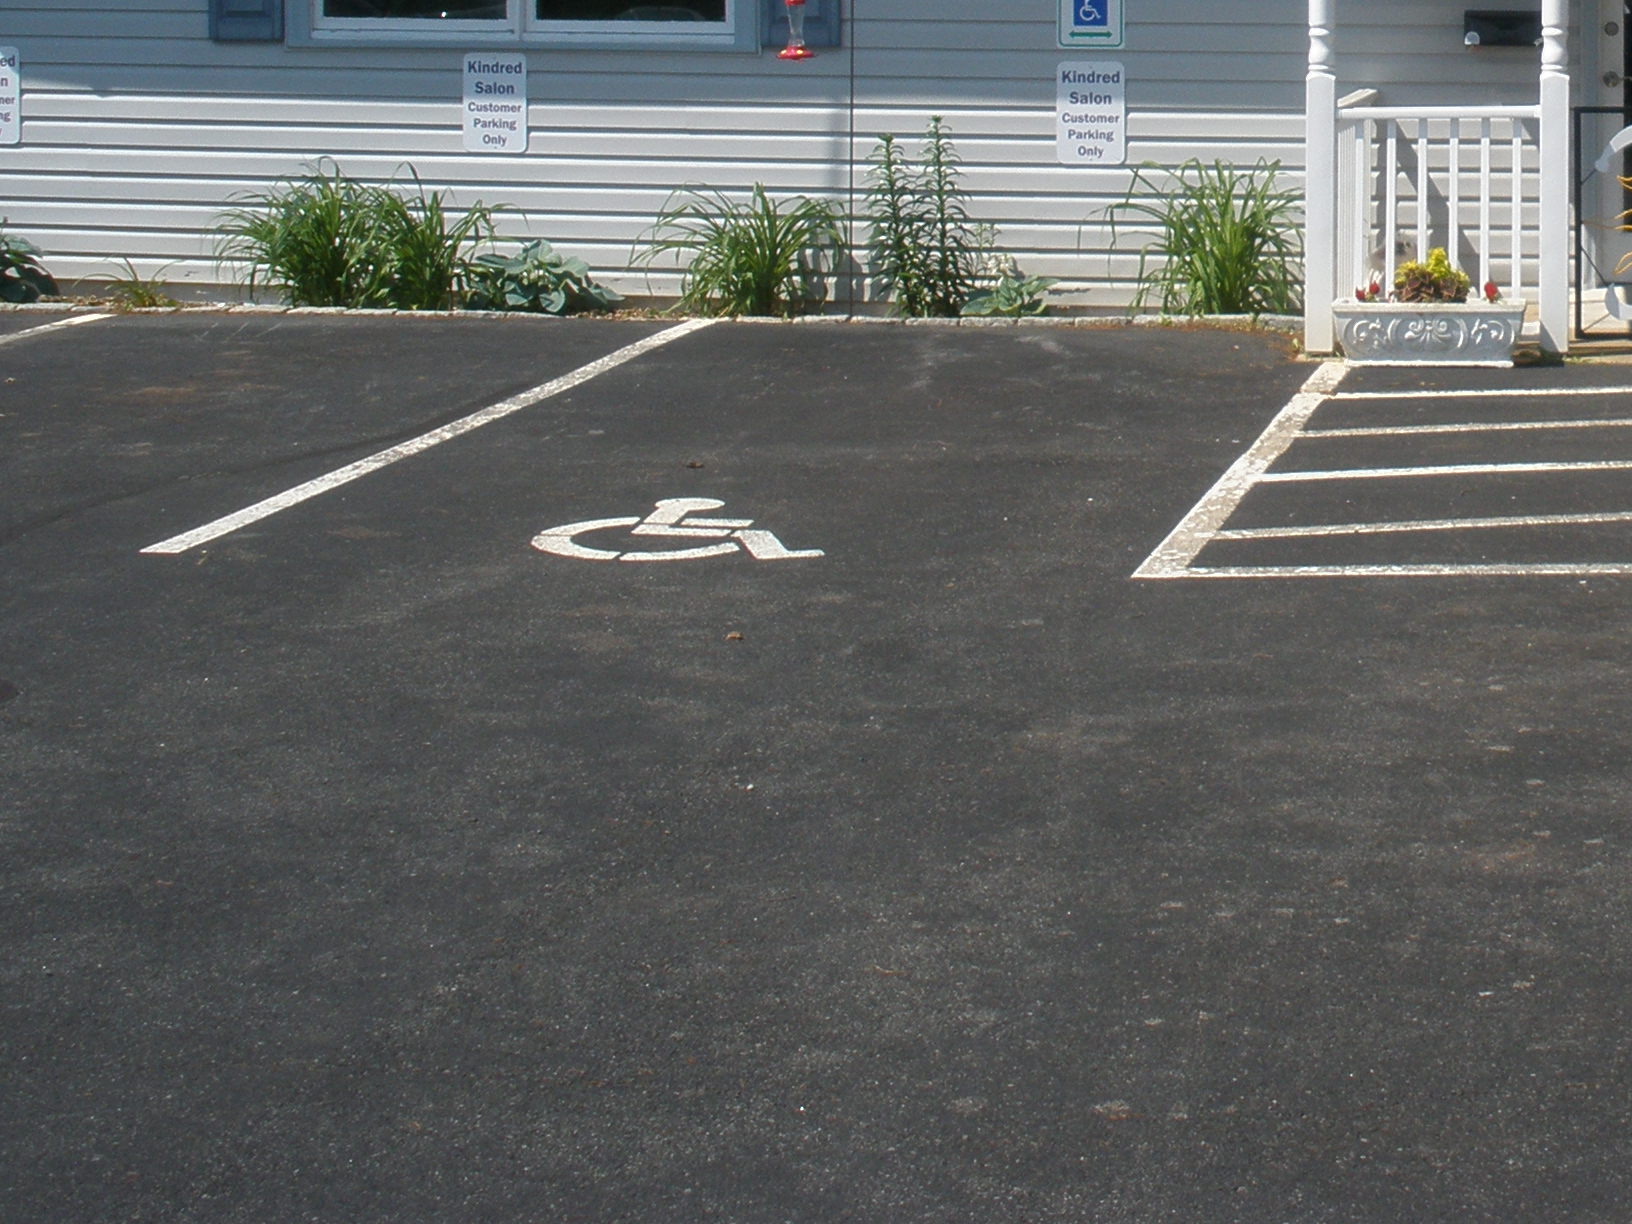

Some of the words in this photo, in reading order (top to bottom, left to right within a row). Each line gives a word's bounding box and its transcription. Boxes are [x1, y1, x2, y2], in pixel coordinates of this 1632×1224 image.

[467, 61, 522, 74] Kindred
[1062, 70, 1120, 84] Kindred
[475, 82, 515, 94] Salon
[1069, 91, 1112, 105] Salon
[468, 102, 522, 113] Customer
[474, 118, 517, 131] Parking
[1062, 112, 1120, 124] Customer
[482, 134, 507, 147] Only
[1068, 129, 1114, 142] Parking
[1077, 146, 1104, 159] Only
